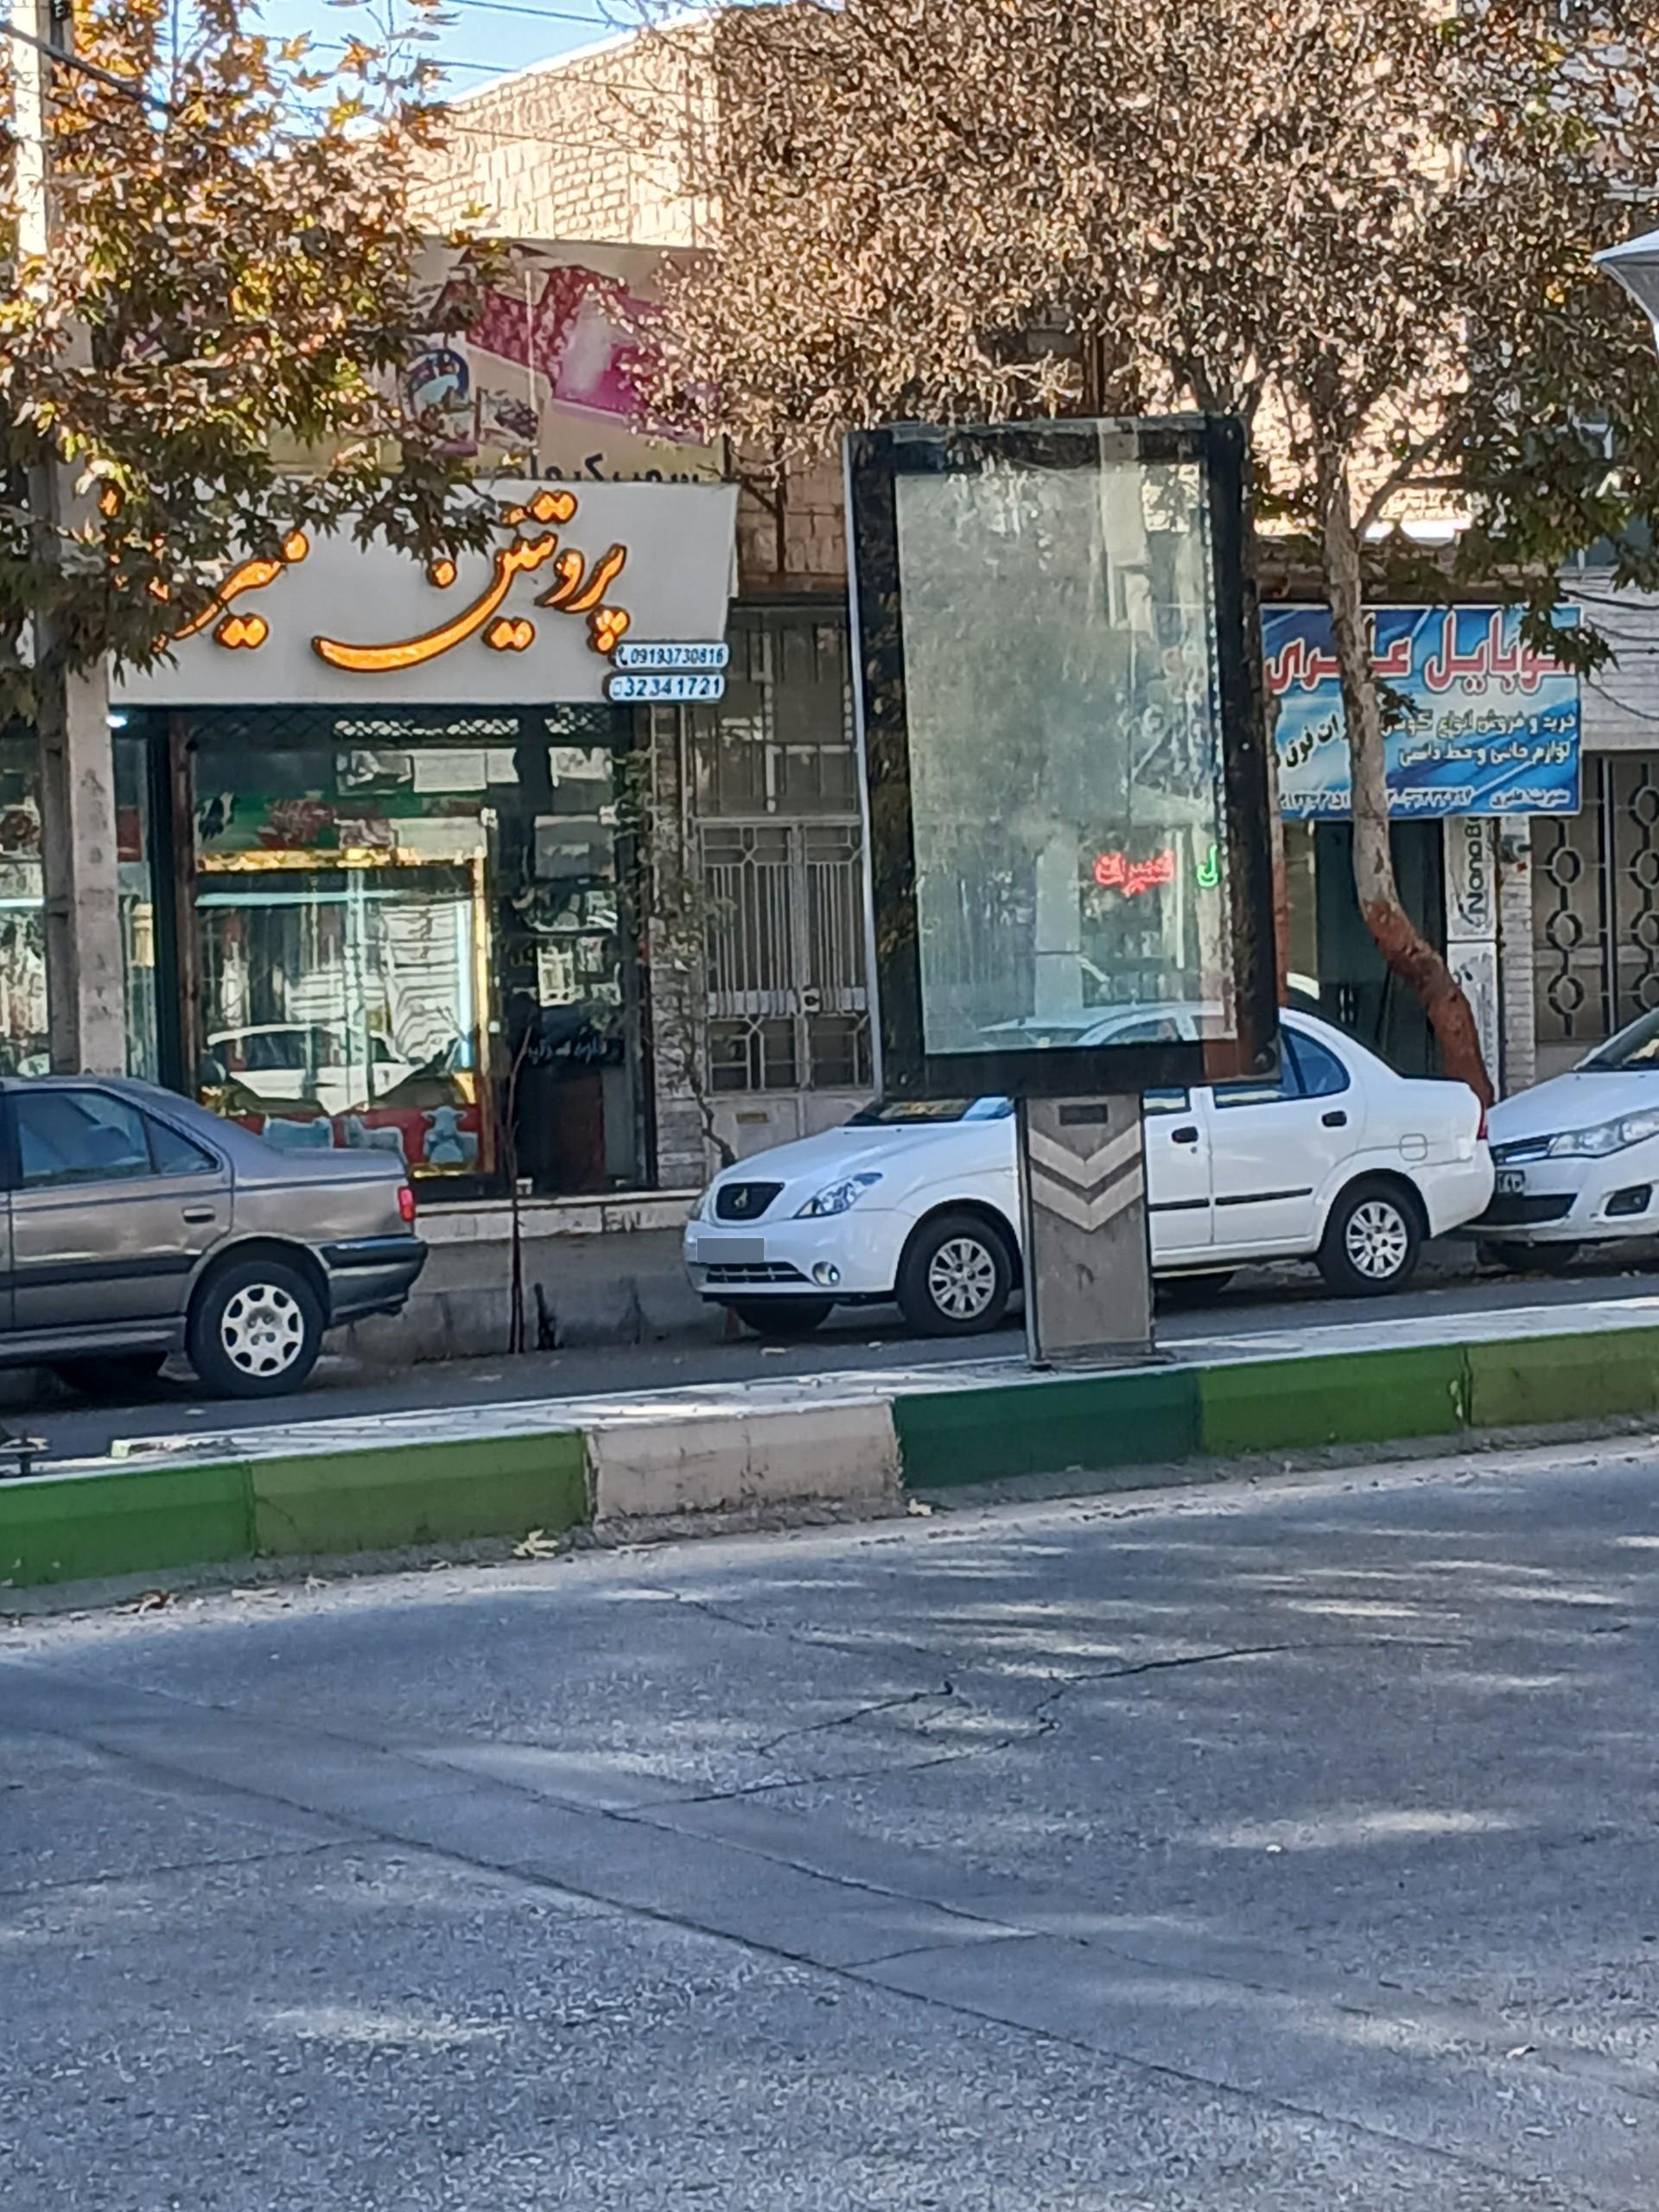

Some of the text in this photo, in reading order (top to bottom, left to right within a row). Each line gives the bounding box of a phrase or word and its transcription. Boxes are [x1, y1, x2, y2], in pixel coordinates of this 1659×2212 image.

[624, 677, 721, 696] 32341721
[1266, 612, 1412, 695] عاری
[1465, 817, 1484, 914] NanoB
